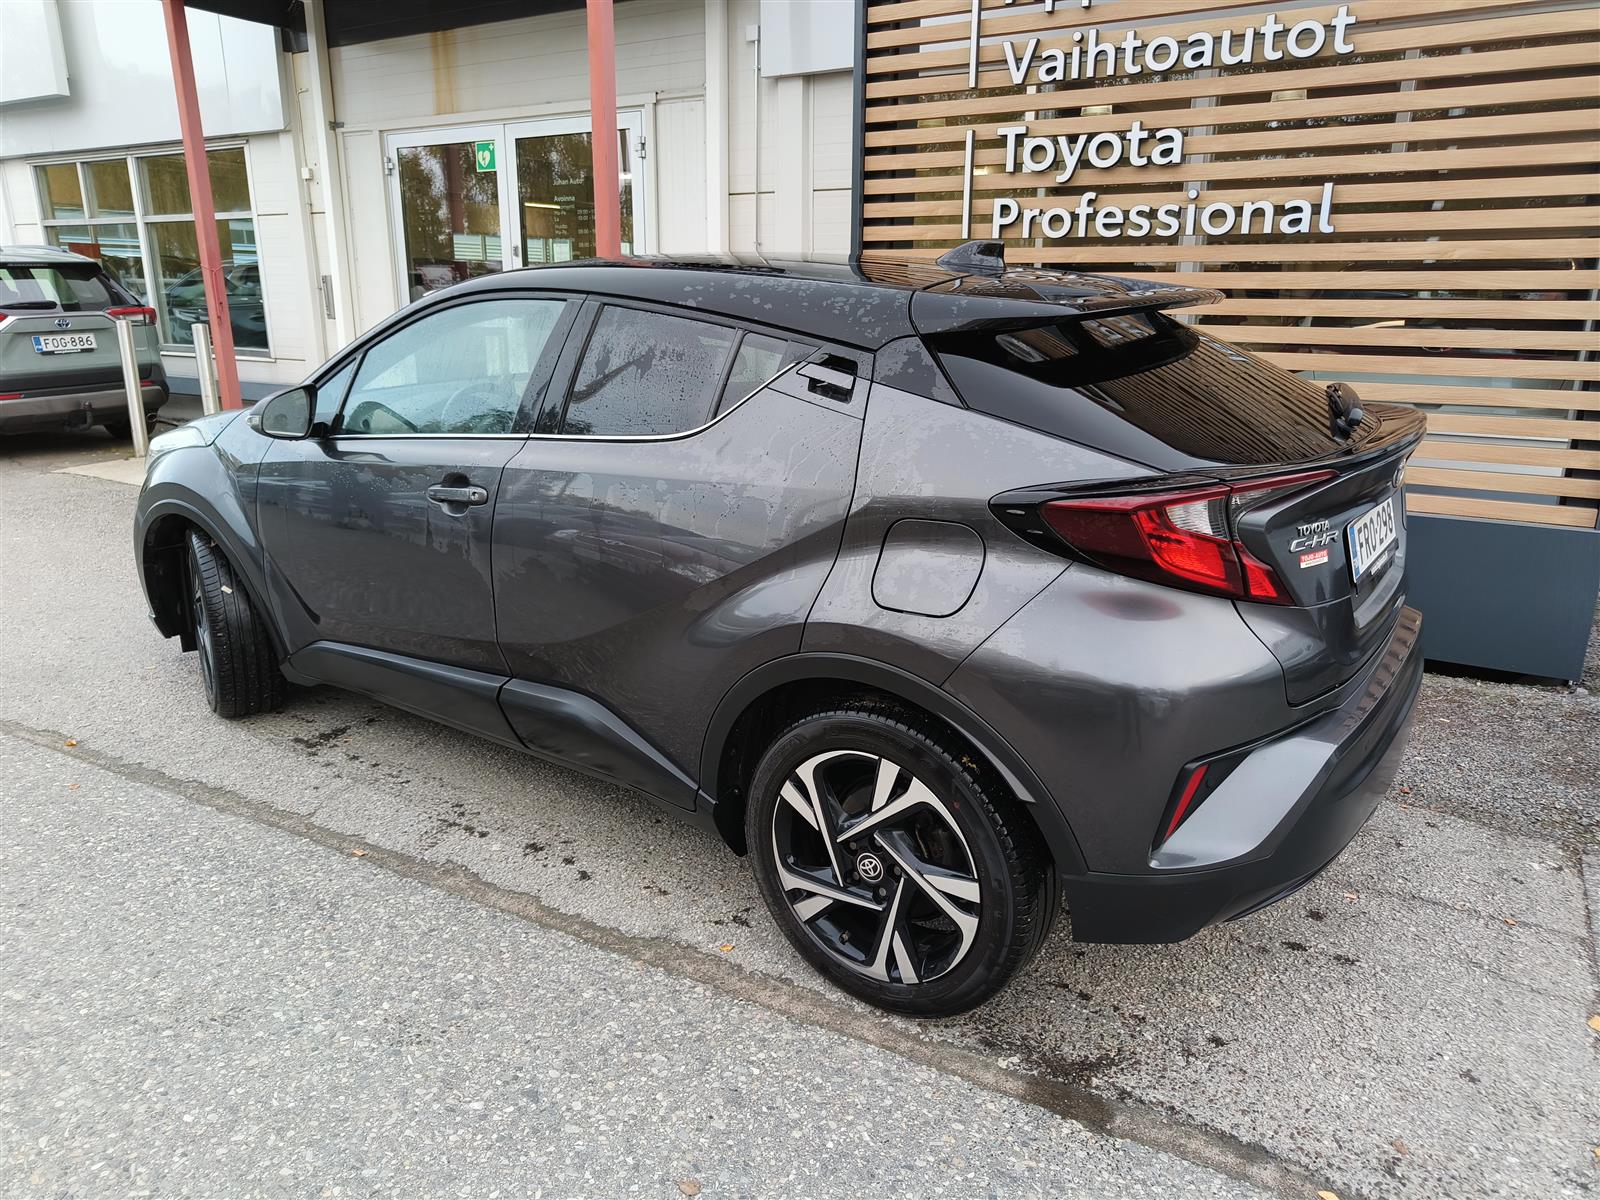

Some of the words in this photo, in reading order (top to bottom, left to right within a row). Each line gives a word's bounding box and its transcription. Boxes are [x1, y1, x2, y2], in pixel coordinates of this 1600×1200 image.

[1002, 5, 1358, 86] Vaihtoautot
[996, 120, 1185, 184] Toyota
[991, 182, 1337, 240] Professional
[1290, 530, 1339, 552] C-HR
[1298, 520, 1330, 535] TOYOTA
